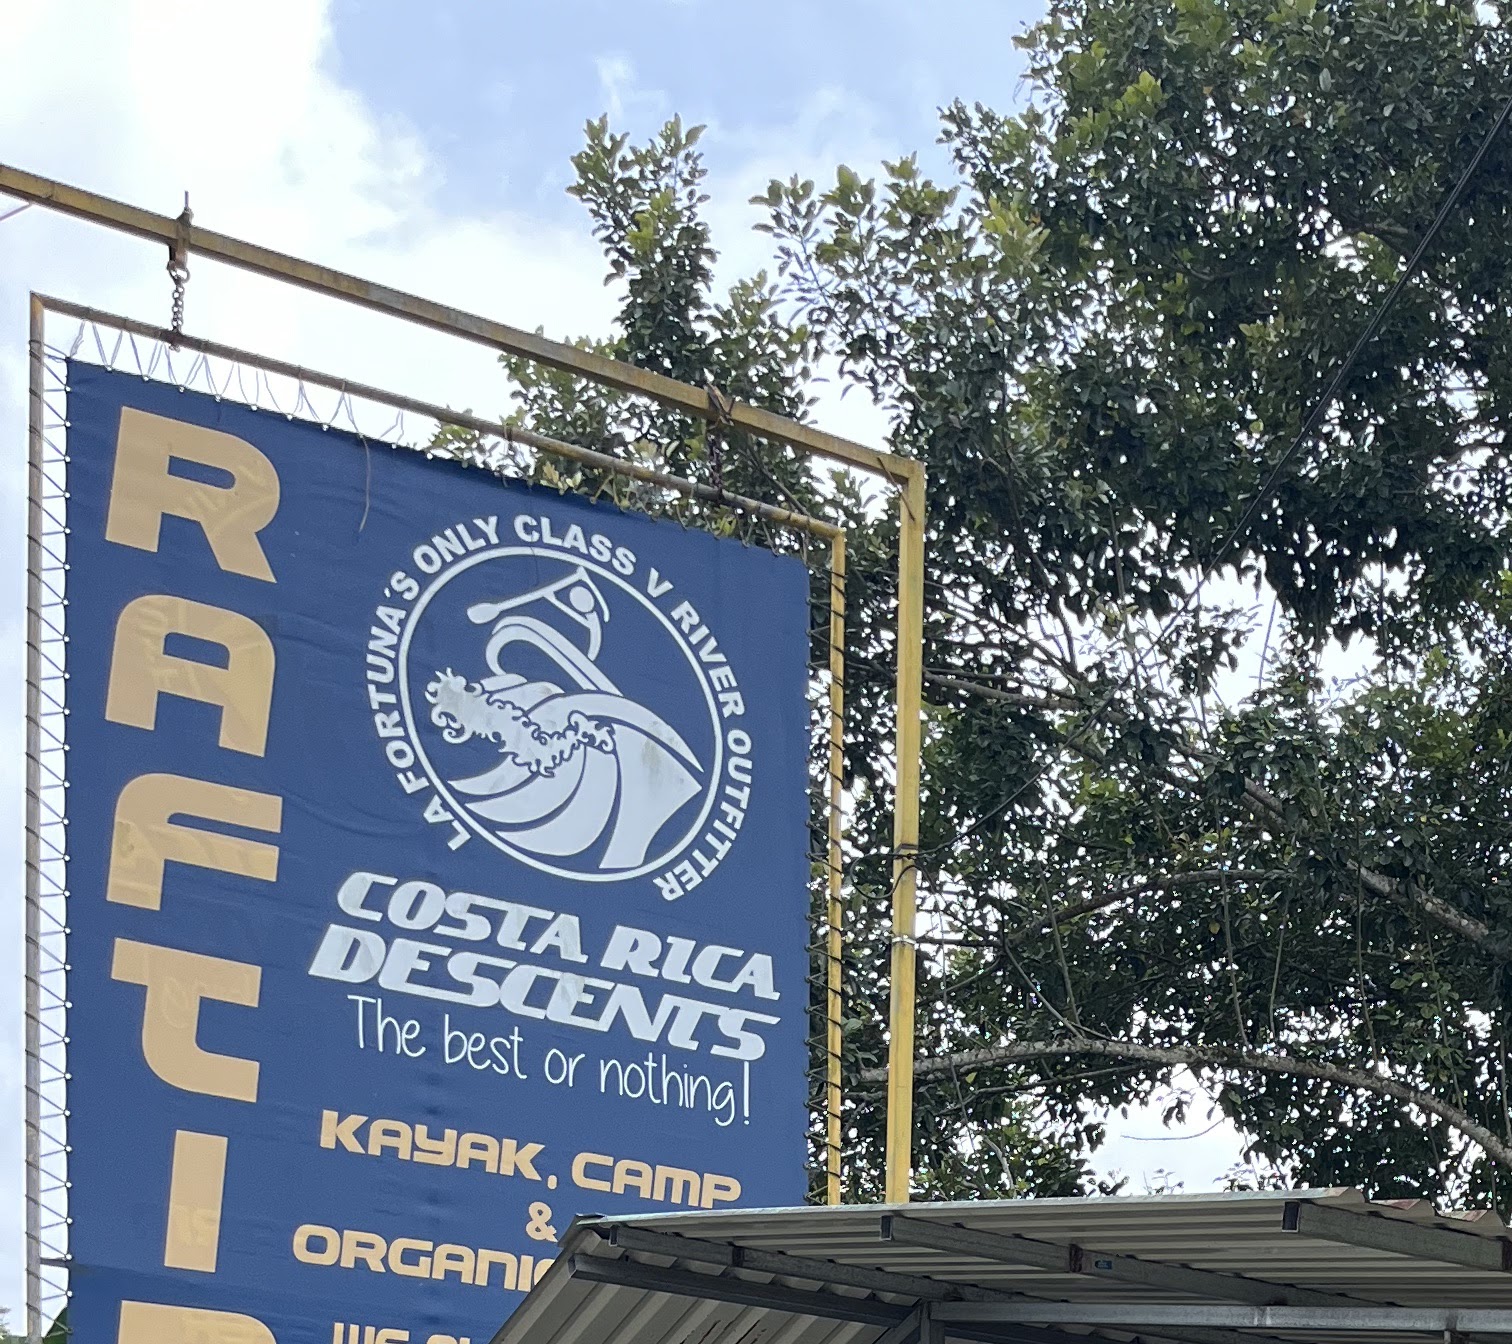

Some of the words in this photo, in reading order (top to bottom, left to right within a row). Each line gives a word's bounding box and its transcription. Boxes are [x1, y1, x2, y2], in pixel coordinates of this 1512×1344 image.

[413, 515, 500, 575] ONLY
[514, 513, 638, 576] CLASS
[646, 568, 673, 598] V
[671, 601, 745, 718] RIVER
[423, 794, 471, 851] LA
[652, 729, 753, 902] OUTFITTER
[336, 871, 589, 965] COSTA
[600, 924, 781, 1001] RICA
[307, 922, 782, 1062] DESCENTS
[347, 994, 427, 1058] The
[443, 1012, 528, 1080] best
[543, 1047, 586, 1088] or
[599, 1051, 752, 1127] nothing!
[319, 1109, 558, 1190] KAYAK,
[571, 1151, 743, 1209] CAMP
[525, 1201, 559, 1243] &
